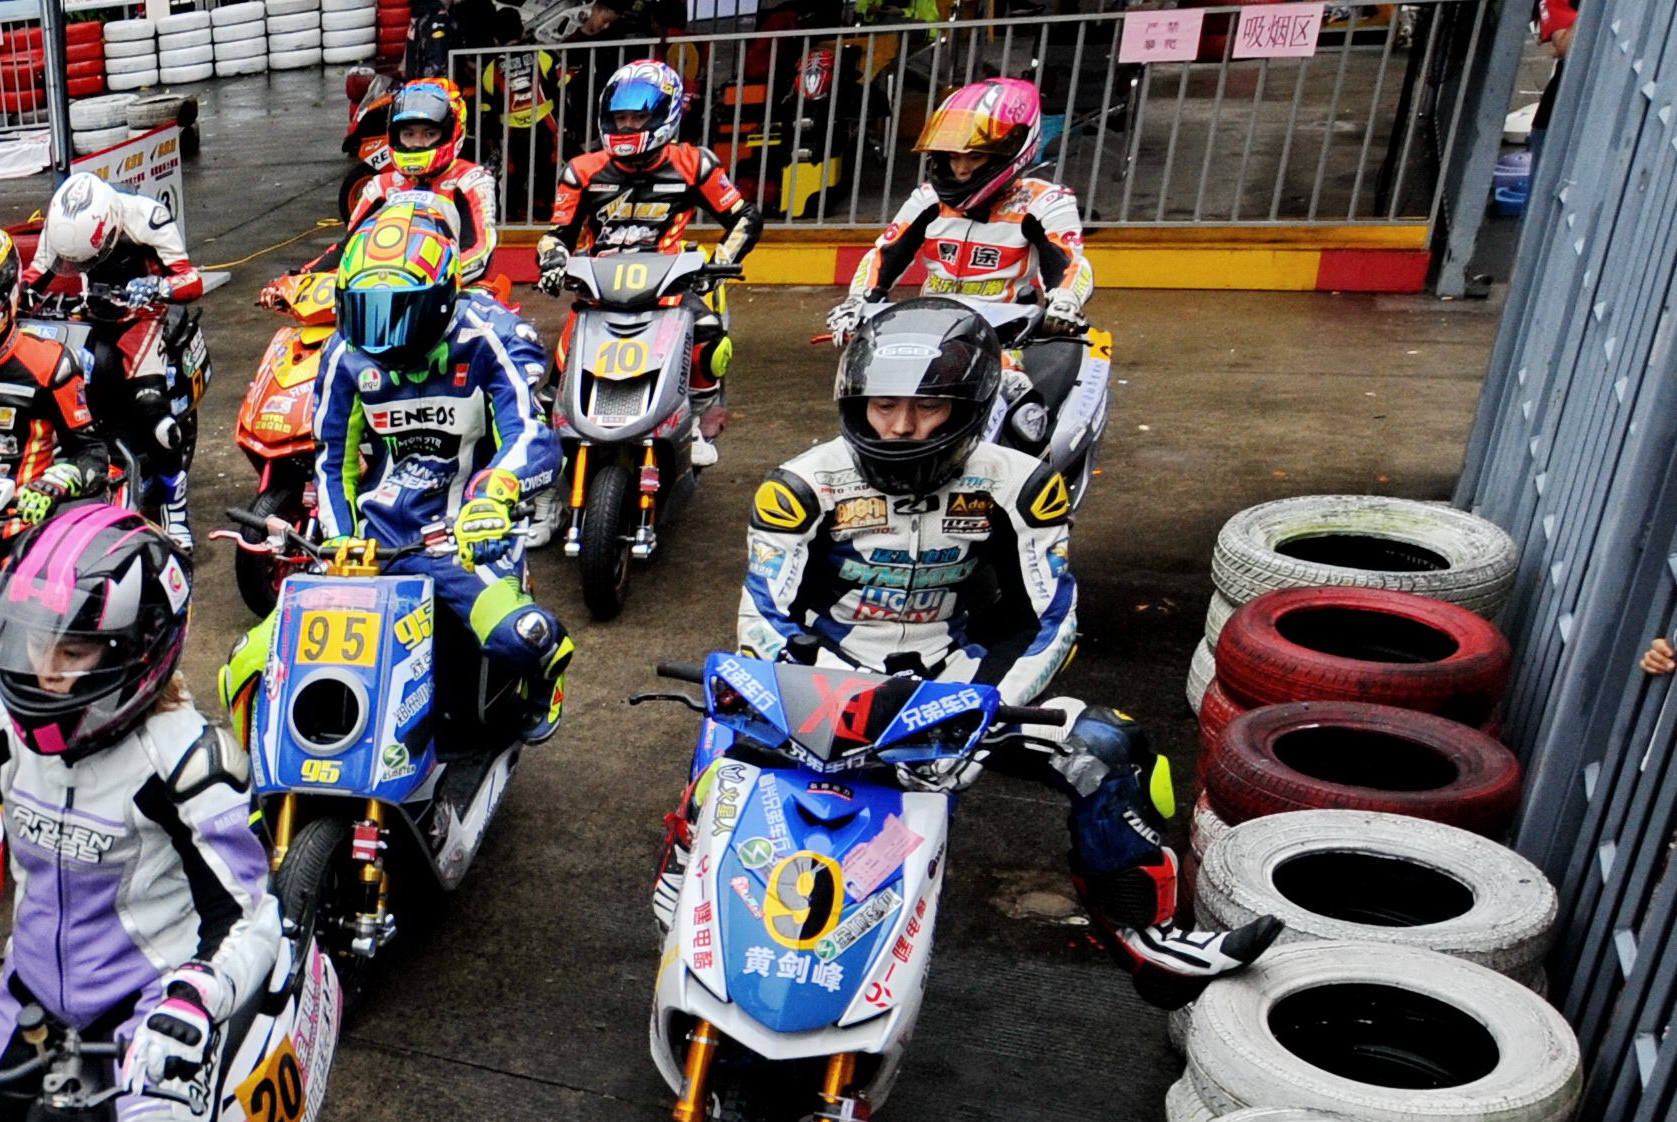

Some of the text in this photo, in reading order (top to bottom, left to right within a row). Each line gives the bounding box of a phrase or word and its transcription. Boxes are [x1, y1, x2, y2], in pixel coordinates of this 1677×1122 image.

[1243, 14, 1315, 49] 吸烟区
[613, 263, 648, 291] 10
[599, 341, 644, 374] 10
[390, 406, 455, 428] ENEOS
[304, 616, 367, 662] 95
[393, 598, 433, 651] 95
[716, 659, 778, 711] 兄弟车行
[902, 687, 981, 731] 兄弟车行
[301, 759, 344, 784] 95
[12, 804, 113, 852] ARLEN
[711, 786, 740, 838] 火星人
[18, 825, 102, 865] NESS
[772, 856, 836, 942] 9
[742, 945, 845, 993] 黄剑峰
